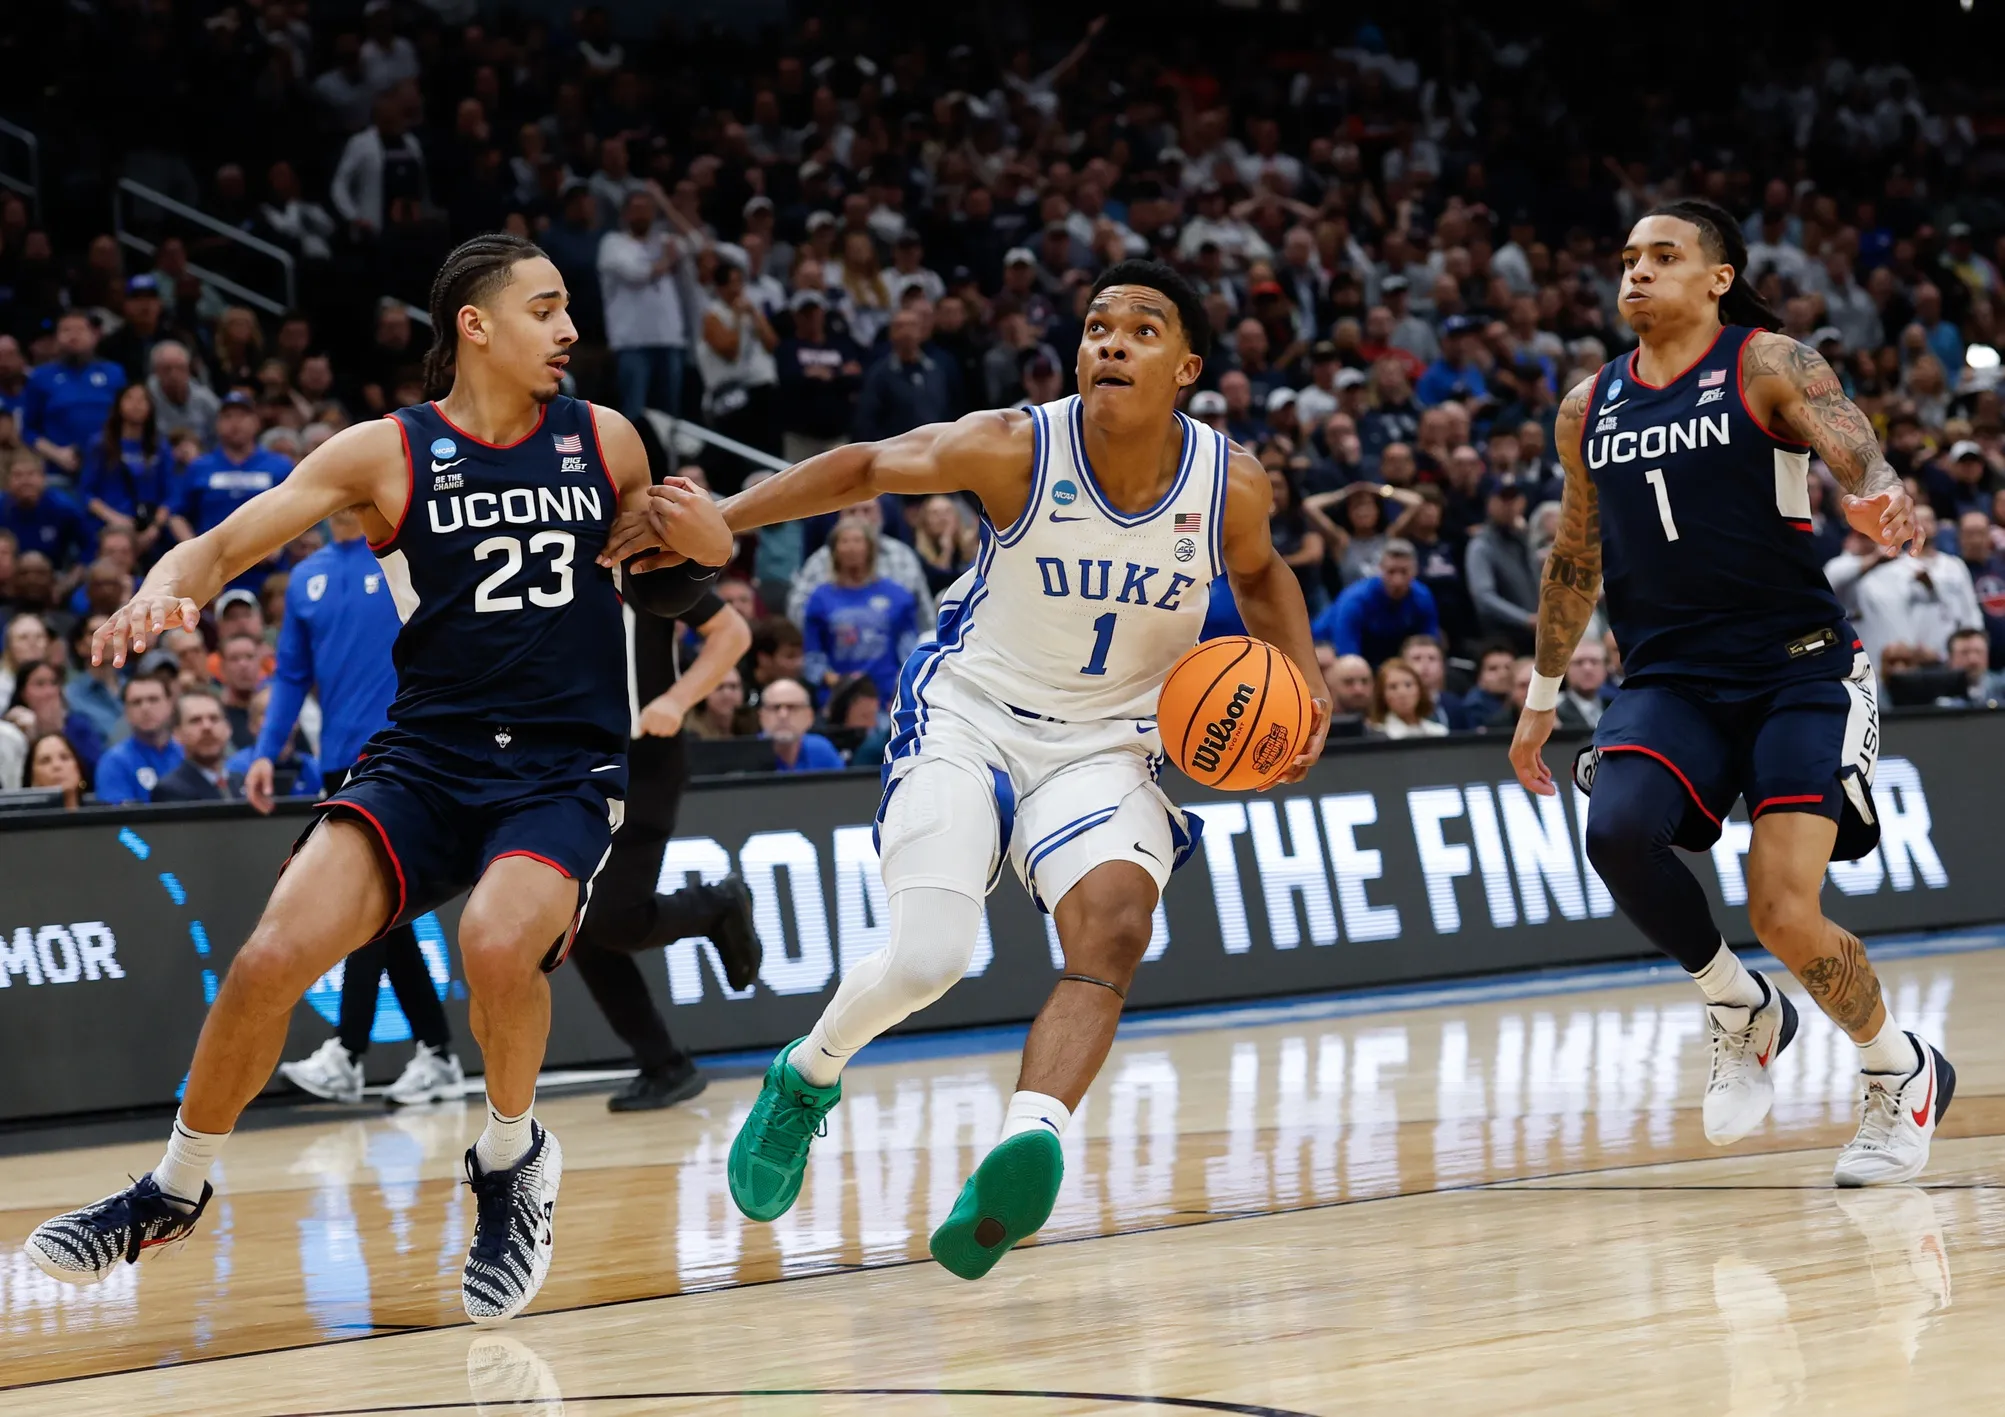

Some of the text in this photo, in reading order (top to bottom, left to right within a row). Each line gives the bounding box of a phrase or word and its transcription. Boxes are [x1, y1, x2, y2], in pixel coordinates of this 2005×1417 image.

[562, 456, 582, 464] BIG
[1587, 412, 1731, 470] UCONN
[433, 479, 465, 492] CHANGE
[435, 473, 463, 484] BE THE
[561, 463, 588, 471] EAST
[427, 486, 602, 534] UCONN
[1053, 490, 1075, 501] NCAA
[1644, 467, 1680, 542] 1
[473, 529, 576, 613] 23
[1035, 556, 1196, 611] DUKE
[1080, 612, 1117, 675] 1
[1191, 683, 1257, 773] Wilson
[1228, 722, 1245, 751] EVO NXT
[655, 823, 994, 1005] ROA
[1181, 791, 1401, 954] THE
[1406, 780, 1616, 934] FIN
